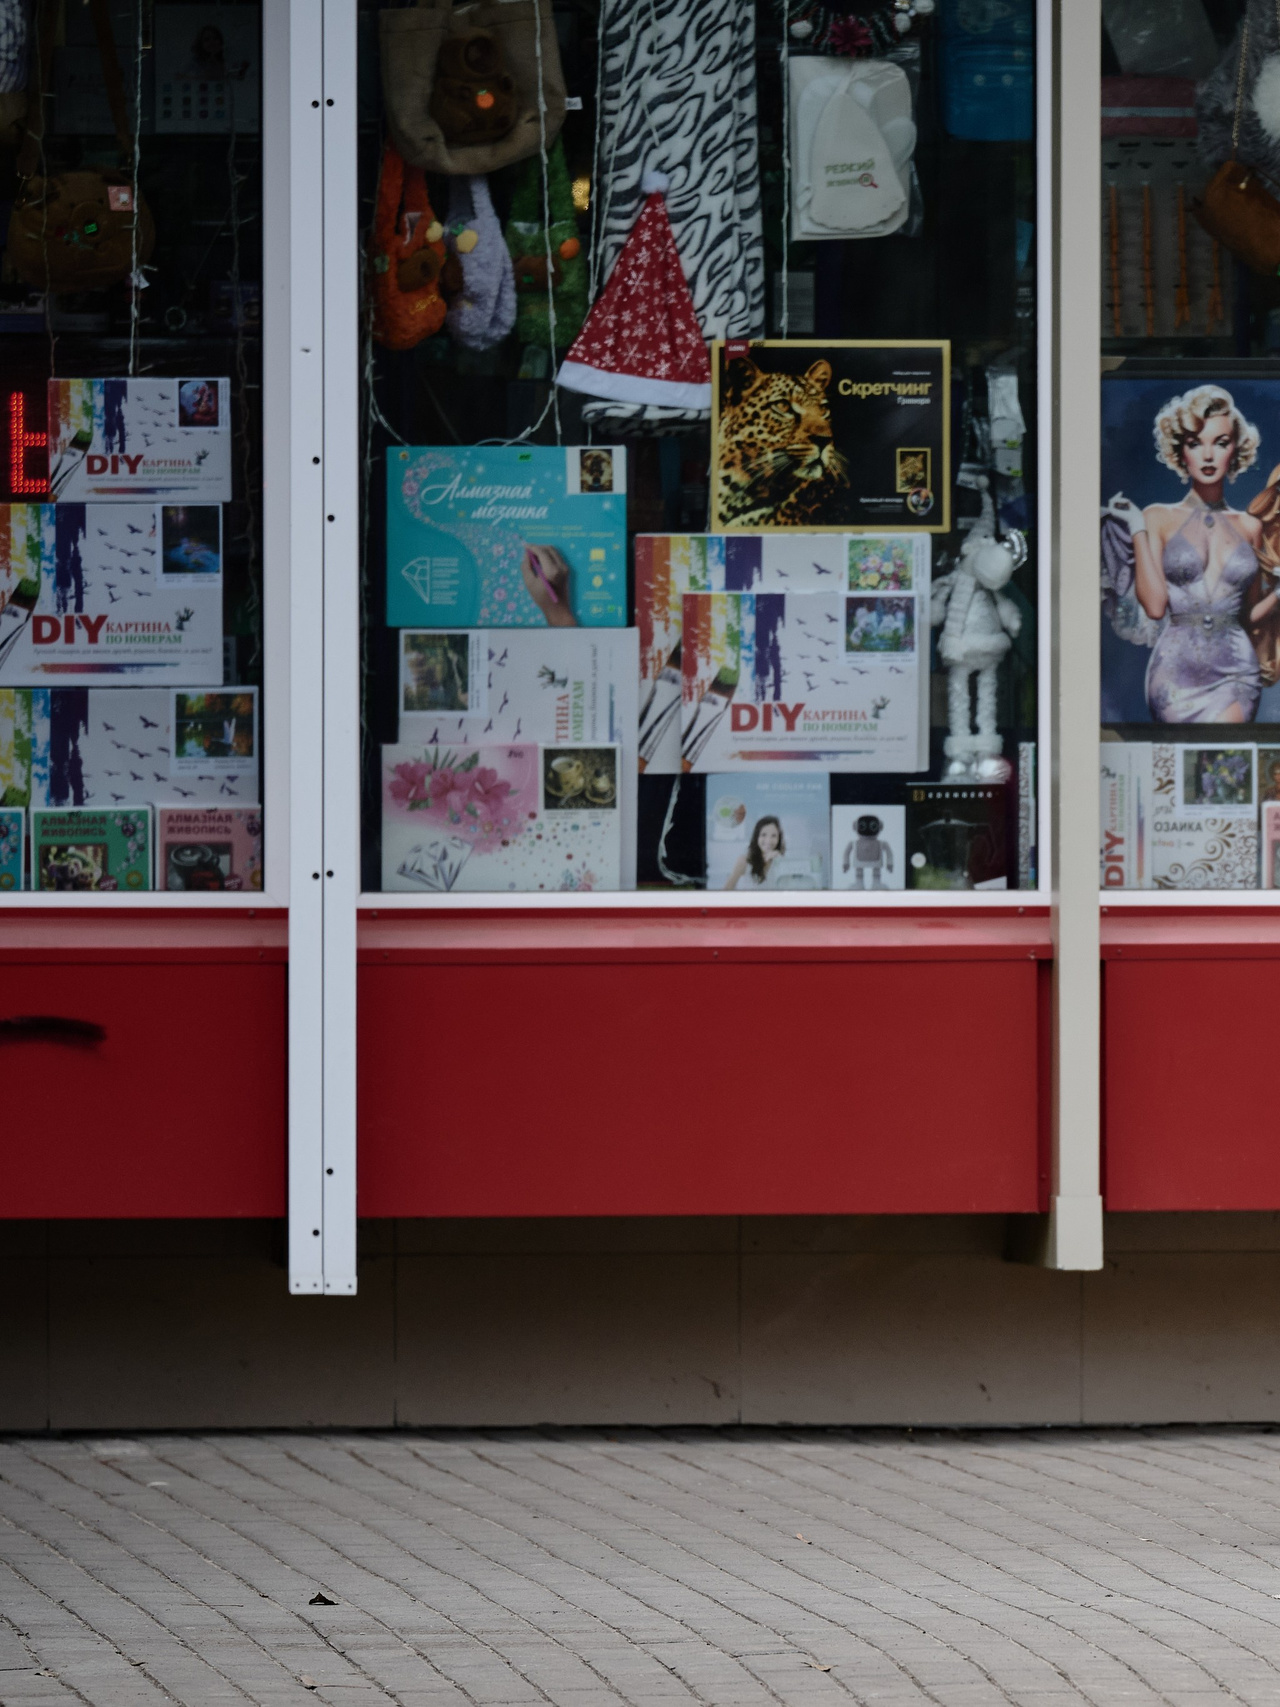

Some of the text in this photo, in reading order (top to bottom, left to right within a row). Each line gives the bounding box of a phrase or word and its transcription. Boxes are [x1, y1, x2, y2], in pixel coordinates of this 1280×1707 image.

[838, 379, 932, 399] Скретчинг
[87, 455, 143, 475] DIY
[142, 459, 193, 468] КАРТИНА
[421, 472, 533, 505] Алмазная
[471, 504, 549, 527] мозаика
[33, 615, 109, 645] DIY
[106, 621, 171, 633] КАРТИНА
[106, 634, 182, 645] ПО НОМЕРАМ
[556, 693, 569, 742] ТИНА
[572, 681, 584, 742] ОМЕРАМ
[731, 703, 805, 732] DIY
[803, 709, 868, 721] КАРТИНА
[803, 722, 878, 732] ПО НОМЕРАМ
[41, 816, 107, 825] АЛМАЗНАЯ
[167, 813, 233, 823] АЛМАЗНАЯ
[41, 828, 107, 837] ЖИВОПИСЬ
[167, 825, 232, 834] ЖИВОПИСЬ
[1153, 821, 1204, 832] ОЗАИКА
[1105, 830, 1125, 887] DIY
